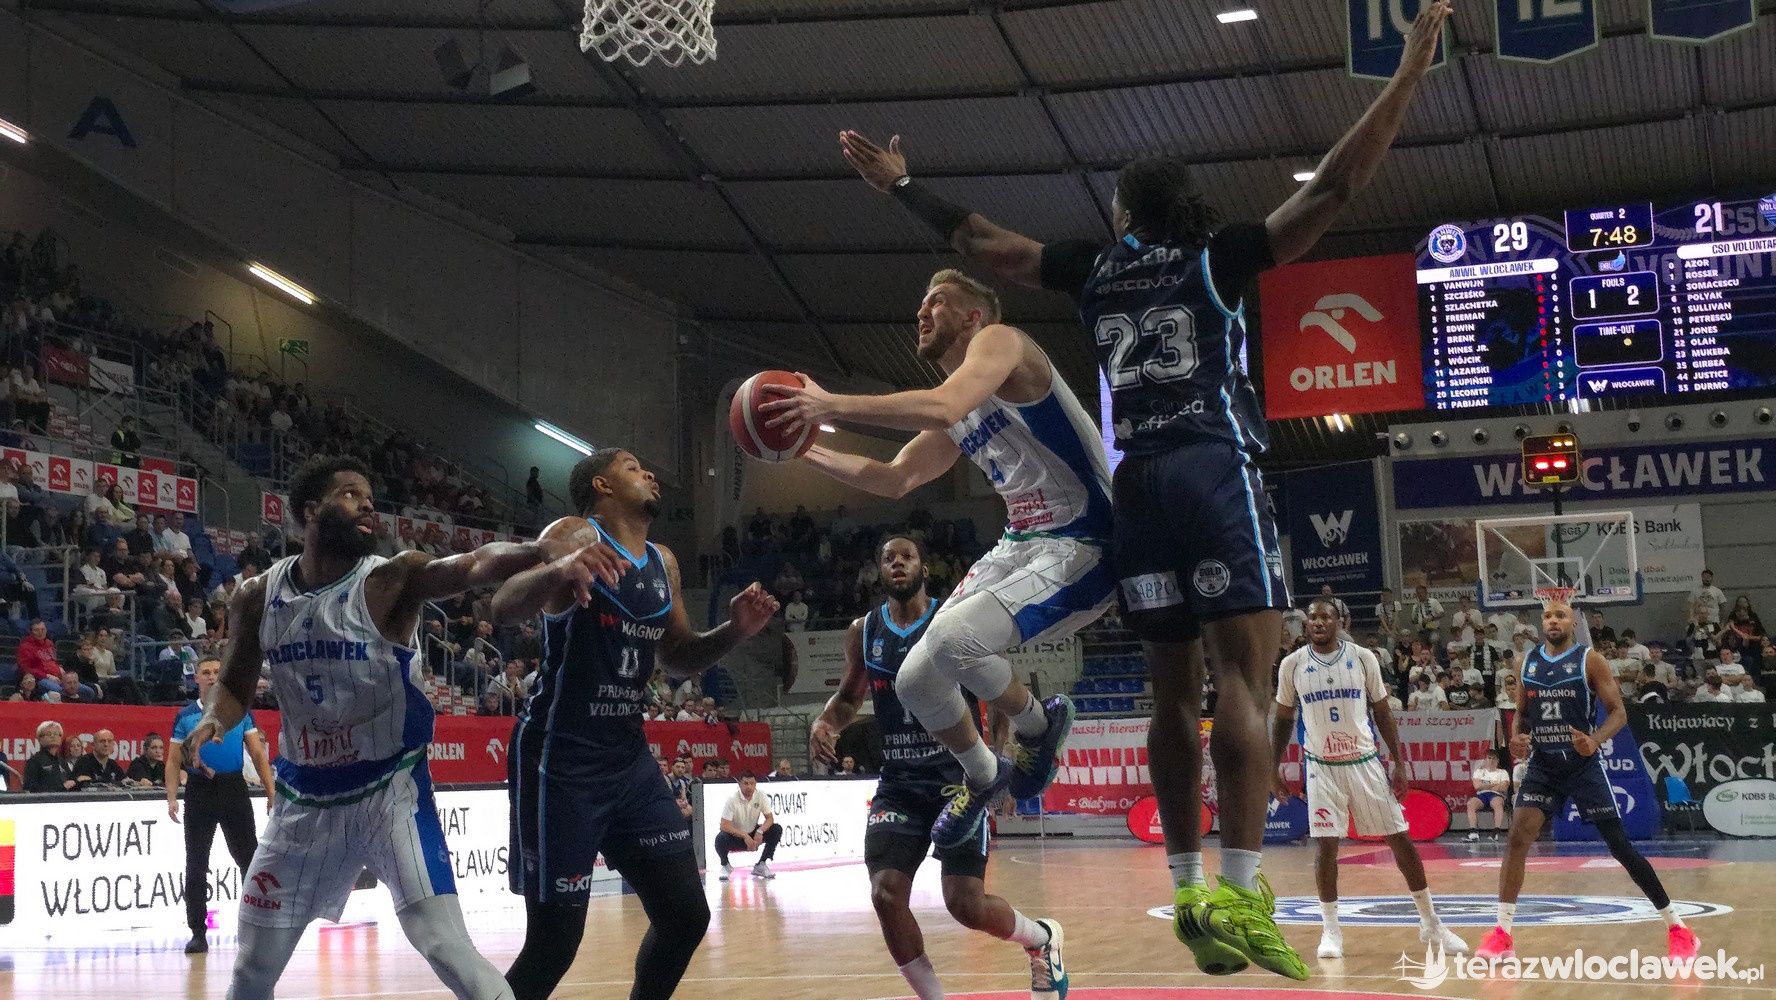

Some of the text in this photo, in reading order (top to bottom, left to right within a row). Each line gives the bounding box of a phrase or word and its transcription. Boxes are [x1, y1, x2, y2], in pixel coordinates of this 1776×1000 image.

[67, 96, 137, 147] A
[1590, 208, 1626, 220] QUARTER 2
[1694, 202, 1723, 233] 21
[1493, 221, 1528, 253] 29
[1590, 225, 1637, 246] 7:48
[1712, 243, 1730, 255] CSO
[1449, 261, 1534, 278] ANWIL WŁOCŁAWEK
[1669, 260, 1710, 270] 0 AZOR
[1686, 270, 1718, 279] ROSSER
[1443, 280, 1484, 290] VANWIJN
[1602, 278, 1625, 288] FOULS
[1686, 279, 1739, 290] SOMACESCU
[1588, 285, 1640, 309] 1 2
[1687, 292, 1723, 302] POLYAK
[1672, 302, 1732, 314] 11 SULLIVAN
[1432, 316, 1437, 324] 5
[1445, 312, 1485, 322] FREEMAN
[1688, 314, 1732, 324] PETRESCU
[1446, 324, 1475, 333] EDWIN
[1598, 325, 1635, 336] TIME-OUT
[1689, 326, 1718, 335] JONES
[1447, 334, 1475, 344] BRENK
[1674, 337, 1716, 348] 22 OLAH
[1094, 304, 1200, 391] 23
[1448, 346, 1472, 355] HINES
[1476, 344, 1490, 352] JR.
[1555, 338, 1561, 346] 7
[1692, 348, 1731, 358] MUKEBA
[1448, 356, 1481, 366] WÓJCIK
[1692, 359, 1726, 369] GIRBEA
[1289, 359, 1397, 392] ORLEN
[1677, 370, 1728, 381] 44 JUSTICE
[1611, 379, 1655, 390] WŁOCŁAWEK
[1694, 382, 1729, 391] DURMO
[1436, 391, 1447, 399] 20
[1450, 388, 1489, 398] LECOMTE
[1437, 402, 1446, 410] 21
[1451, 398, 1489, 409] PABIJAN
[1473, 448, 1764, 497] WCŁAWEK
[1645, 519, 1681, 533] Bank
[1302, 552, 1369, 570] WŁOCŁAWEK
[305, 674, 324, 705] 5
[1538, 689, 1576, 698] MAGNOR
[1303, 688, 1362, 704] WŁOCŁAWEK
[1329, 707, 1339, 723] 6
[1541, 701, 1562, 720] 21
[1071, 721, 1151, 736] naszej hierarch
[1425, 715, 1474, 730] szczycie
[1646, 714, 1758, 731] Kujawiacy z
[426, 743, 465, 760] ORLEN
[691, 743, 768, 757] ORLEN ORLEN
[42, 820, 157, 862] POWIAT
[660, 835, 668, 843] &
[243, 894, 282, 910] ORLEN
